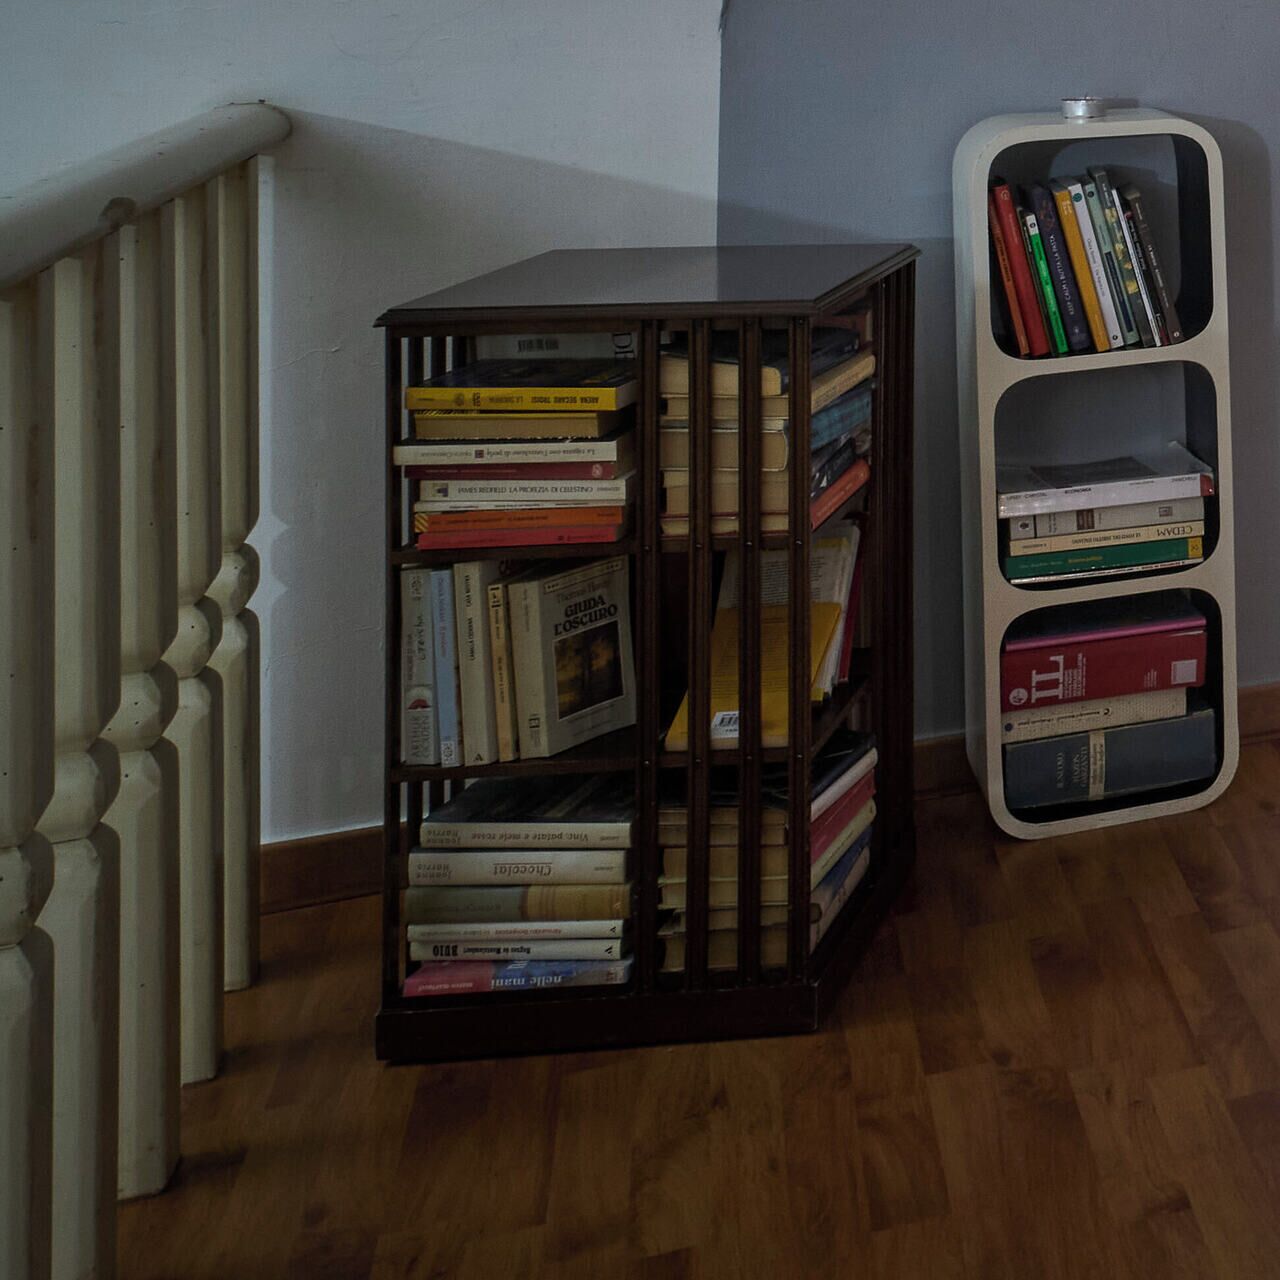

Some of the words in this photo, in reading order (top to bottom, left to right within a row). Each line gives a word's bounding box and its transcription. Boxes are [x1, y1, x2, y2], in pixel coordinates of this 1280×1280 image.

[1049, 233, 1058, 252] PASTA
[1056, 261, 1066, 280] BUTTA
[1062, 285, 1071, 301] CALM
[1157, 525, 1193, 538] CEDAM
[564, 594, 607, 618] GIUDA
[554, 604, 618, 636] L'OSCURO
[1031, 655, 1065, 703] IL
[410, 715, 421, 758] ARTHUR
[471, 832, 496, 840] rosse
[499, 832, 521, 841] mele
[532, 832, 563, 842] patate
[492, 865, 552, 877] Chocolat
[432, 945, 458, 957] BUIO
[490, 976, 526, 989] mani
[529, 975, 563, 988] nelle
